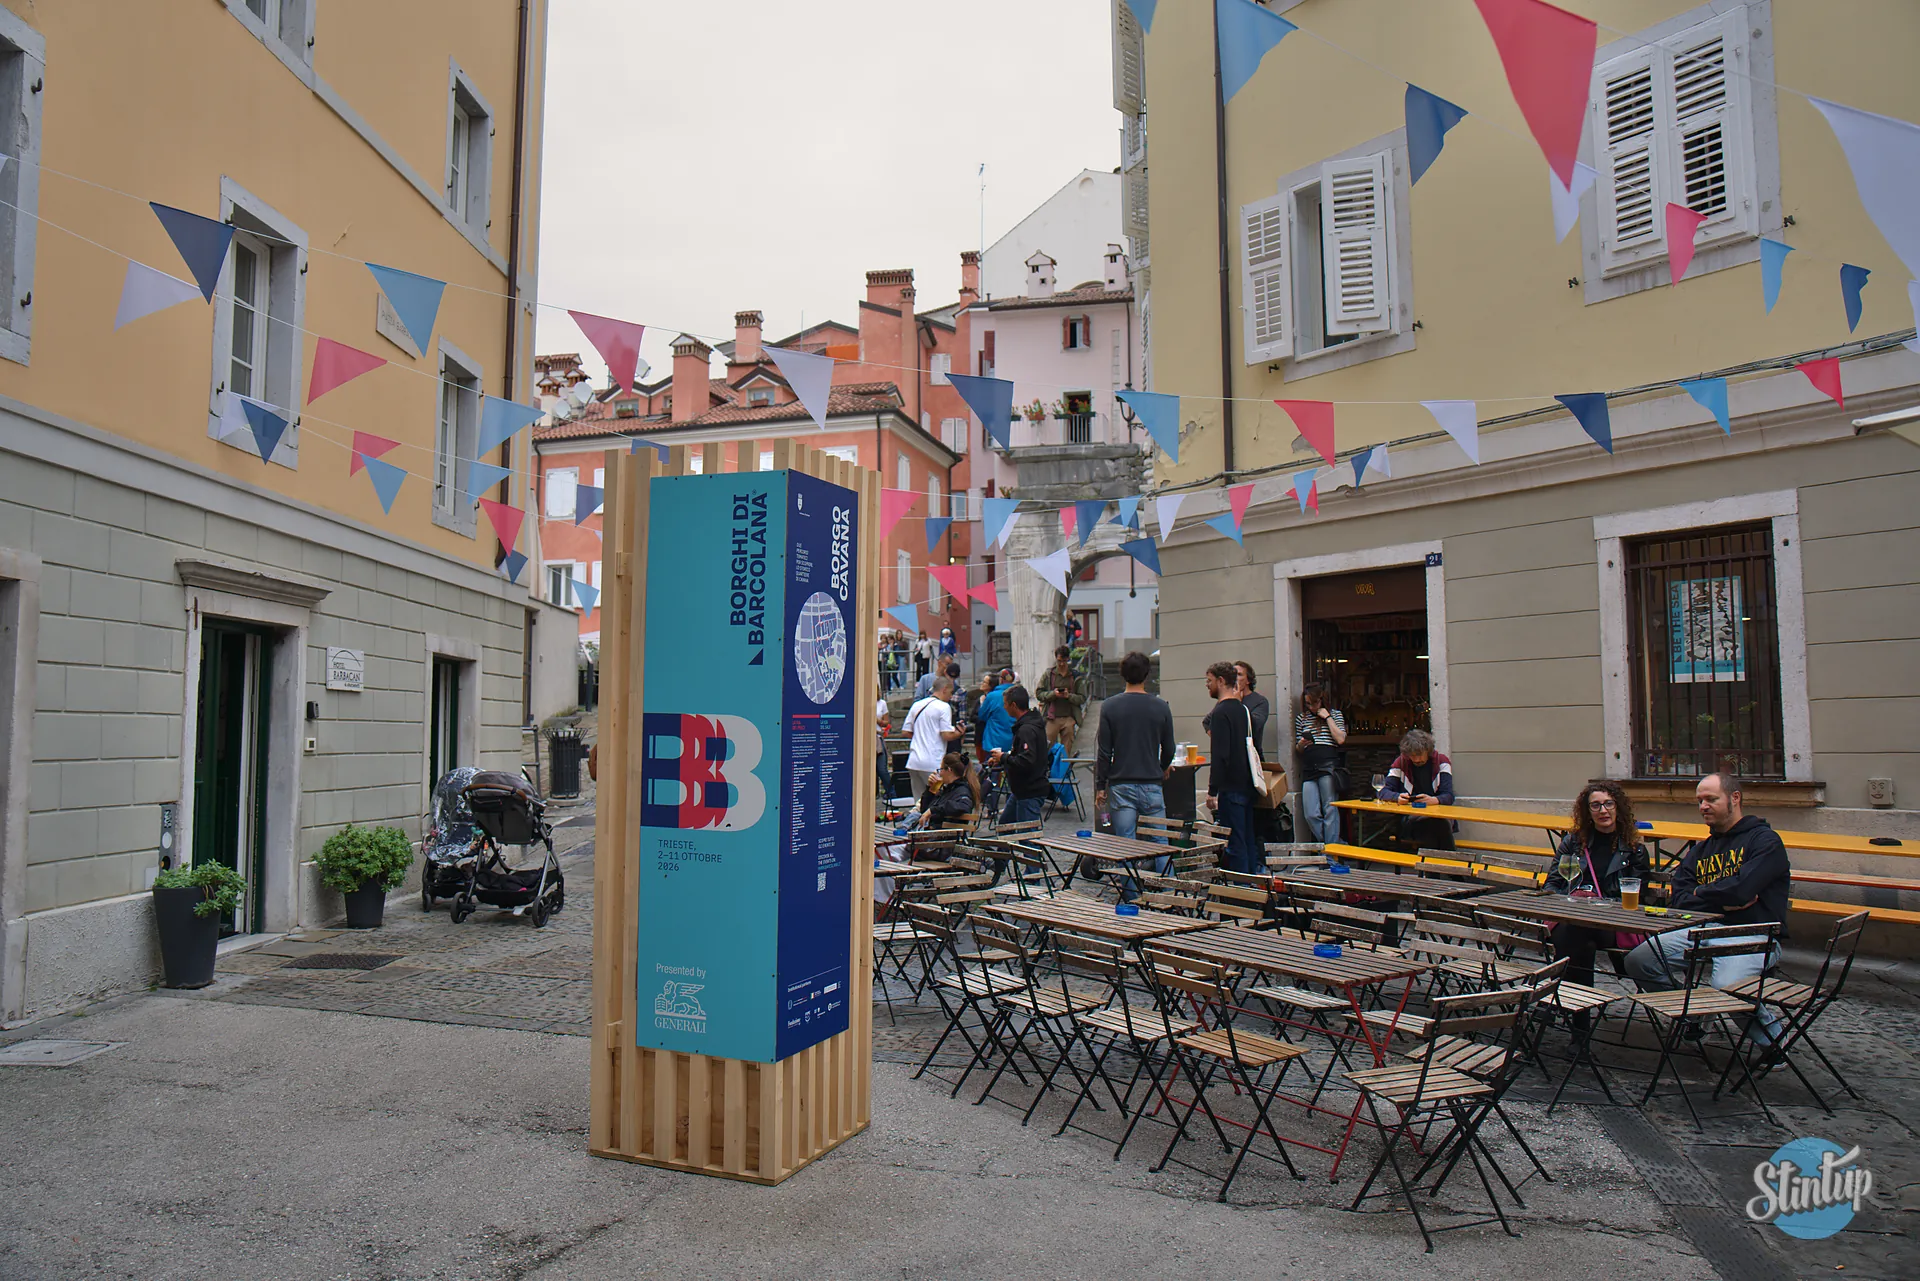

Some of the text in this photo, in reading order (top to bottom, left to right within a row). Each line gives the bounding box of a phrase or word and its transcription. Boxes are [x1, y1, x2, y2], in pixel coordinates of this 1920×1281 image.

[831, 505, 841, 589] BORGO
[840, 508, 850, 602] CAVANA
[730, 493, 750, 625] BORGHI DI
[1355, 583, 1375, 595] VIVA
[1670, 583, 1682, 653] BE THE SEA
[333, 670, 361, 682] BARBACAN
[658, 839, 697, 851] TRIESTE,
[657, 861, 680, 872] 2026
[681, 852, 722, 863] OTTOBRE
[656, 962, 707, 980] Presented by
[654, 1016, 707, 1034] GENERALI
